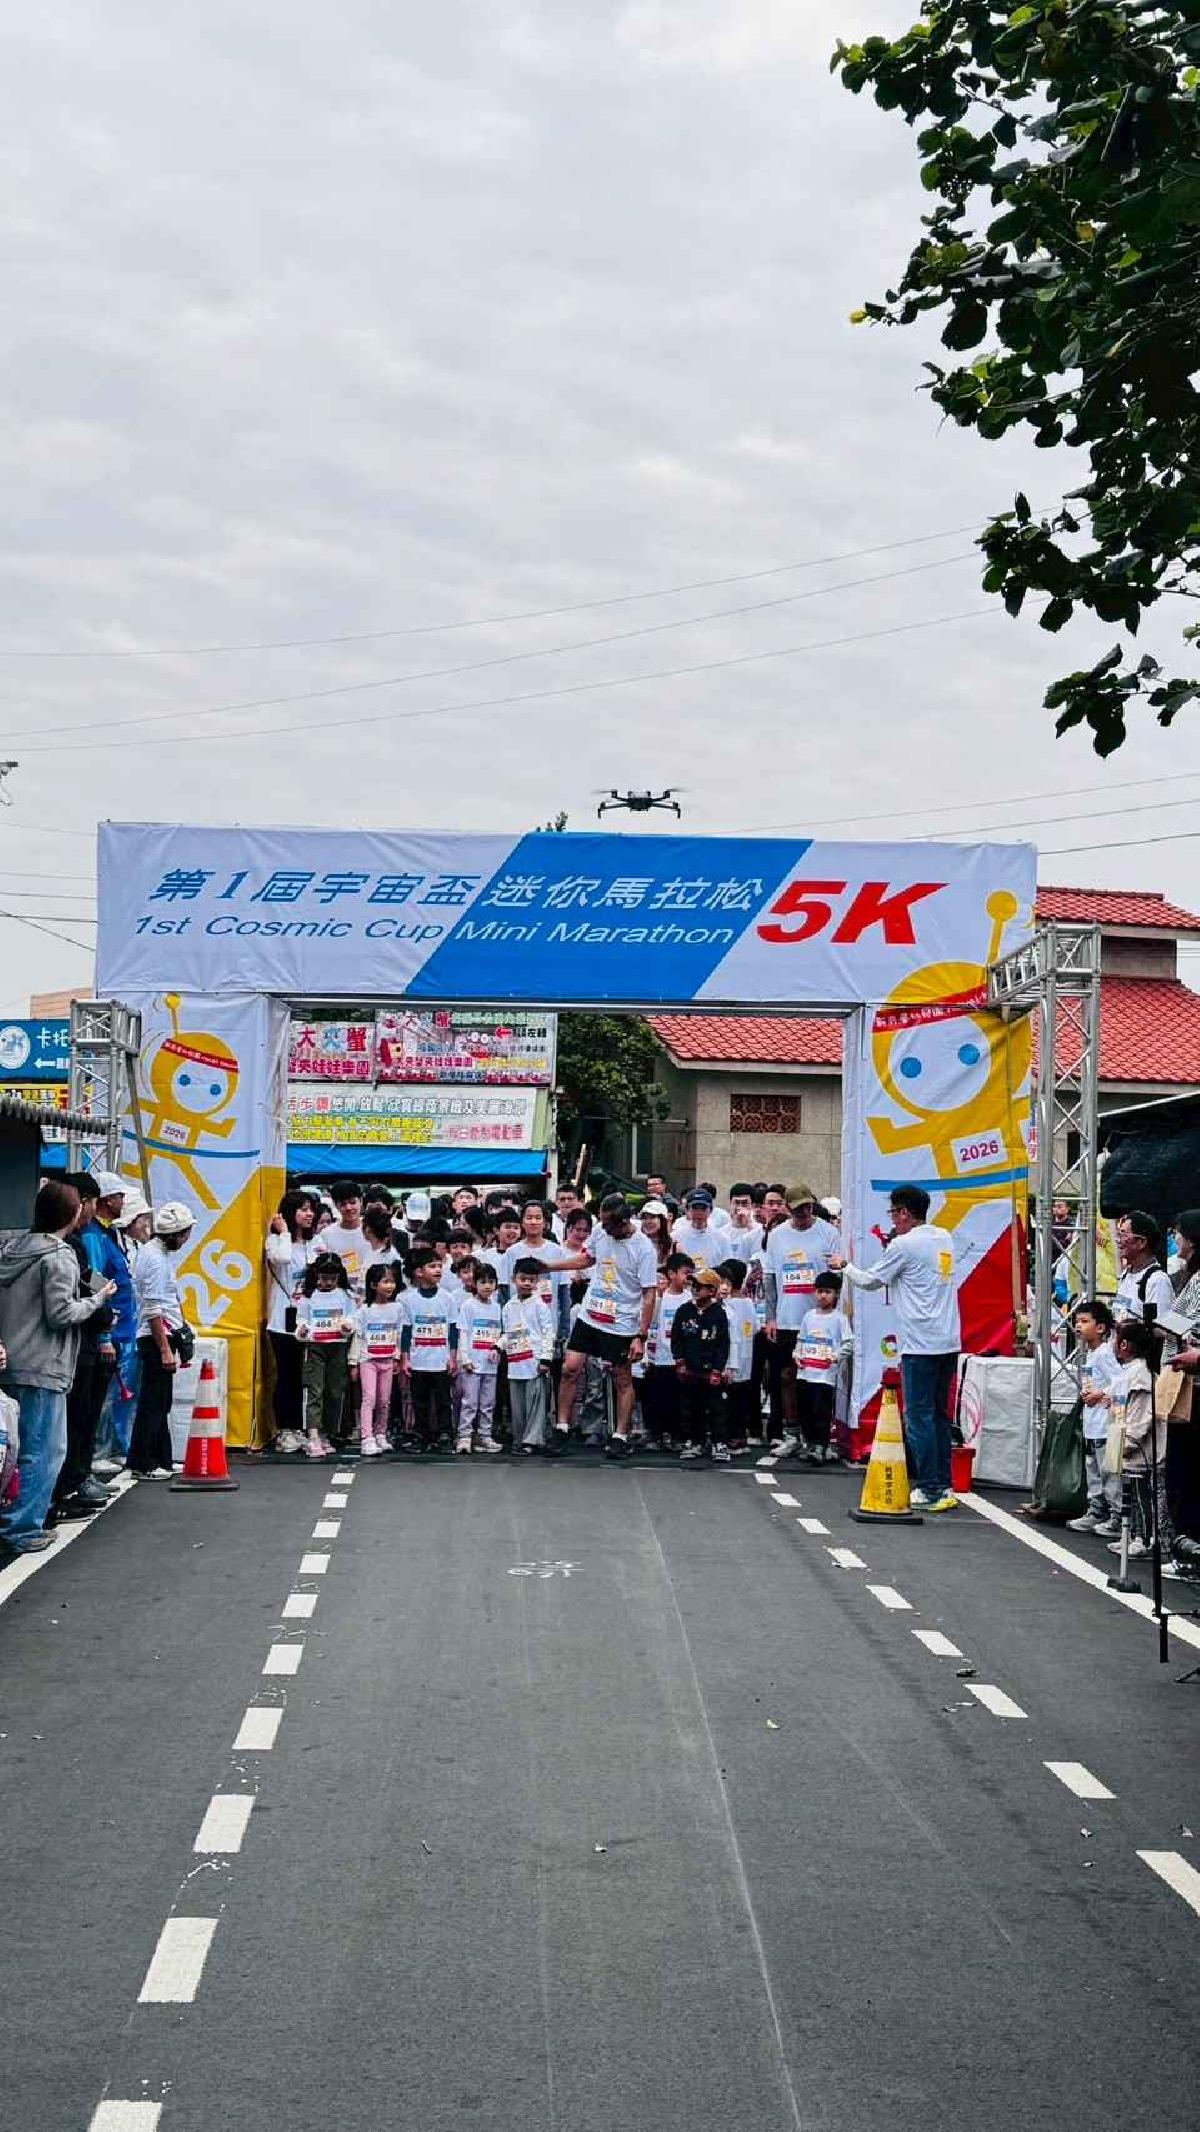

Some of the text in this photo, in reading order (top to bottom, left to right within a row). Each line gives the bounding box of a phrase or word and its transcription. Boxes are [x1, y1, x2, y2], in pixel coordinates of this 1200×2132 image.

[149, 868, 764, 911] 第1屆宇宙盃 迷你馬拉松
[135, 915, 734, 944] 1st Cosmic Cup Mini Marathon
[756, 879, 950, 945] 5K
[959, 1139, 1000, 1162] 2026
